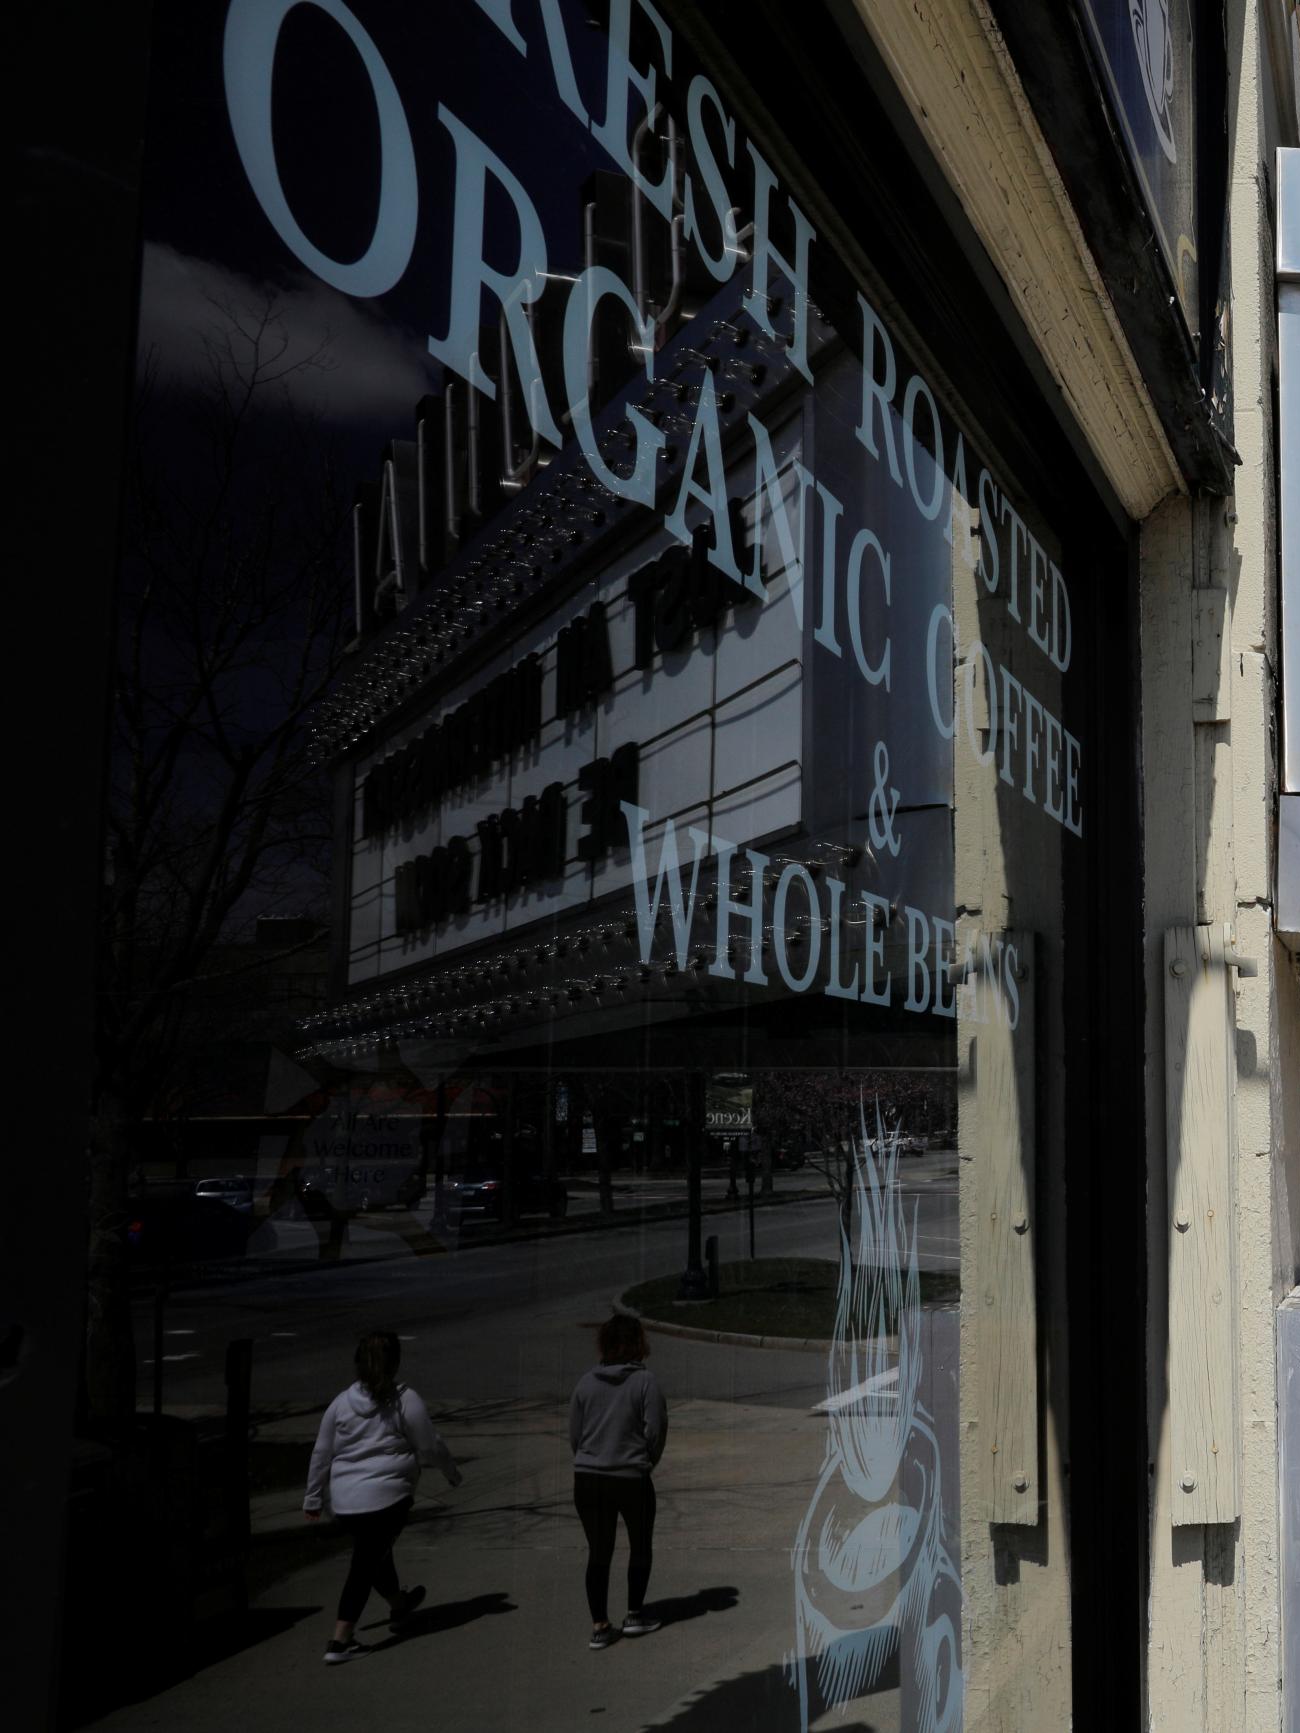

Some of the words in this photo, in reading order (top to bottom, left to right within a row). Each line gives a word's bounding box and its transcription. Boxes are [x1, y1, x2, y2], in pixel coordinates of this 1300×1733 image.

[222, 0, 892, 693] ORGANIC
[925, 602, 1083, 839] COFFEE
[854, 290, 1072, 674] ROASTED
[619, 799, 892, 1007] WHOLE
[903, 904, 1021, 1033] BEANS
[867, 739, 902, 858] &
